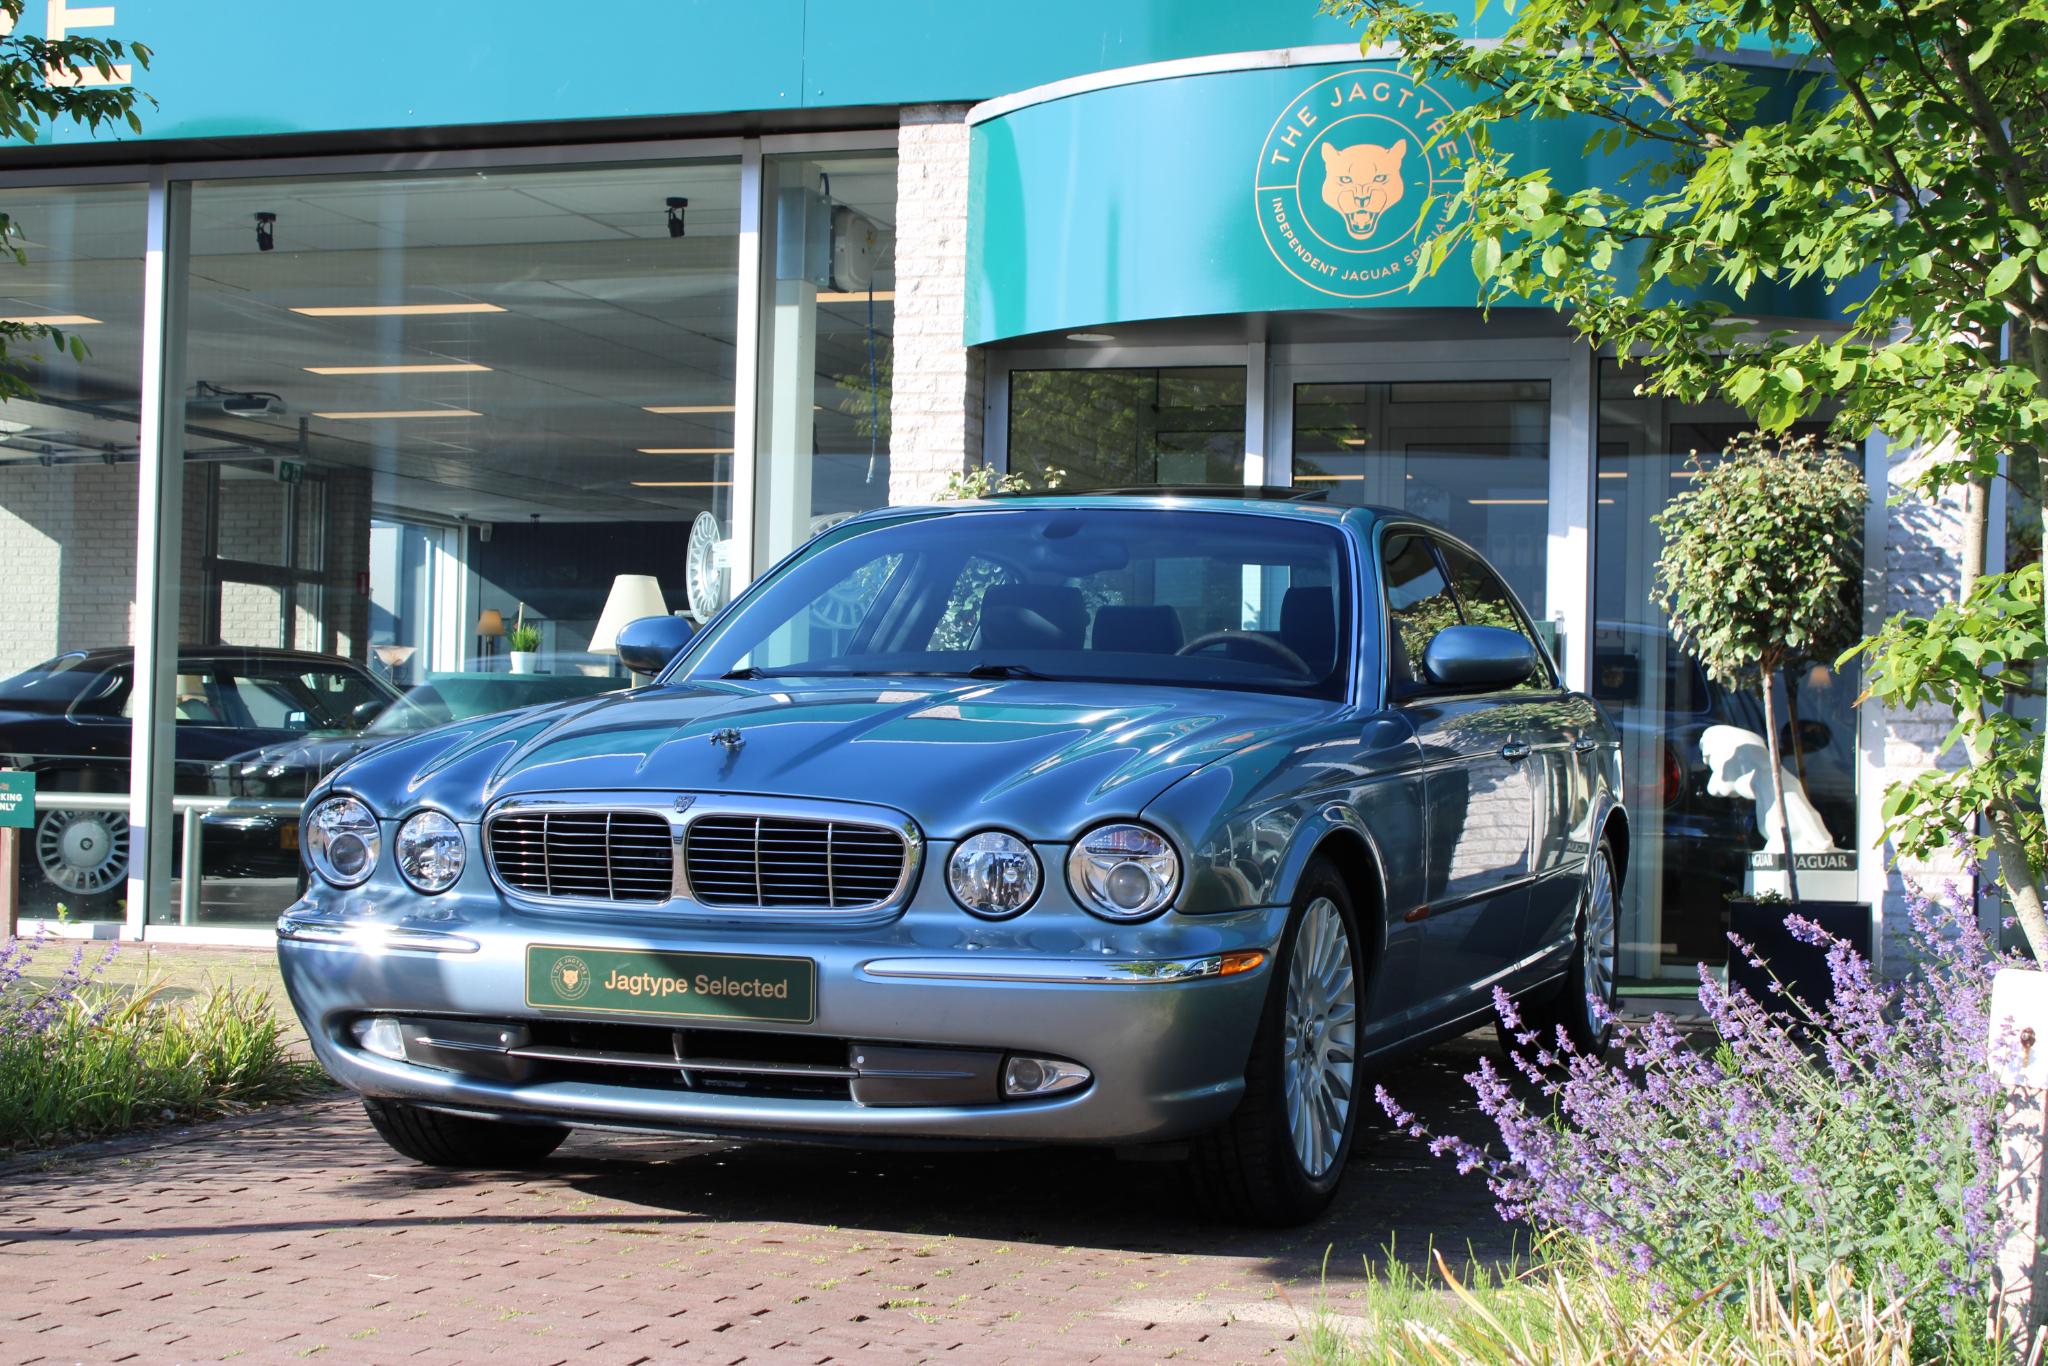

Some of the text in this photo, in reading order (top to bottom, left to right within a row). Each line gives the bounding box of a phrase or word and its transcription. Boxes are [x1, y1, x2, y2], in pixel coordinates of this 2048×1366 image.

[1271, 82, 1458, 165] THE JAGTYPE
[1271, 197, 1337, 277] INDEPENDENT
[1341, 262, 1400, 281] JAGUAR
[604, 970, 688, 997] Jagtype
[694, 974, 788, 998] Selected
